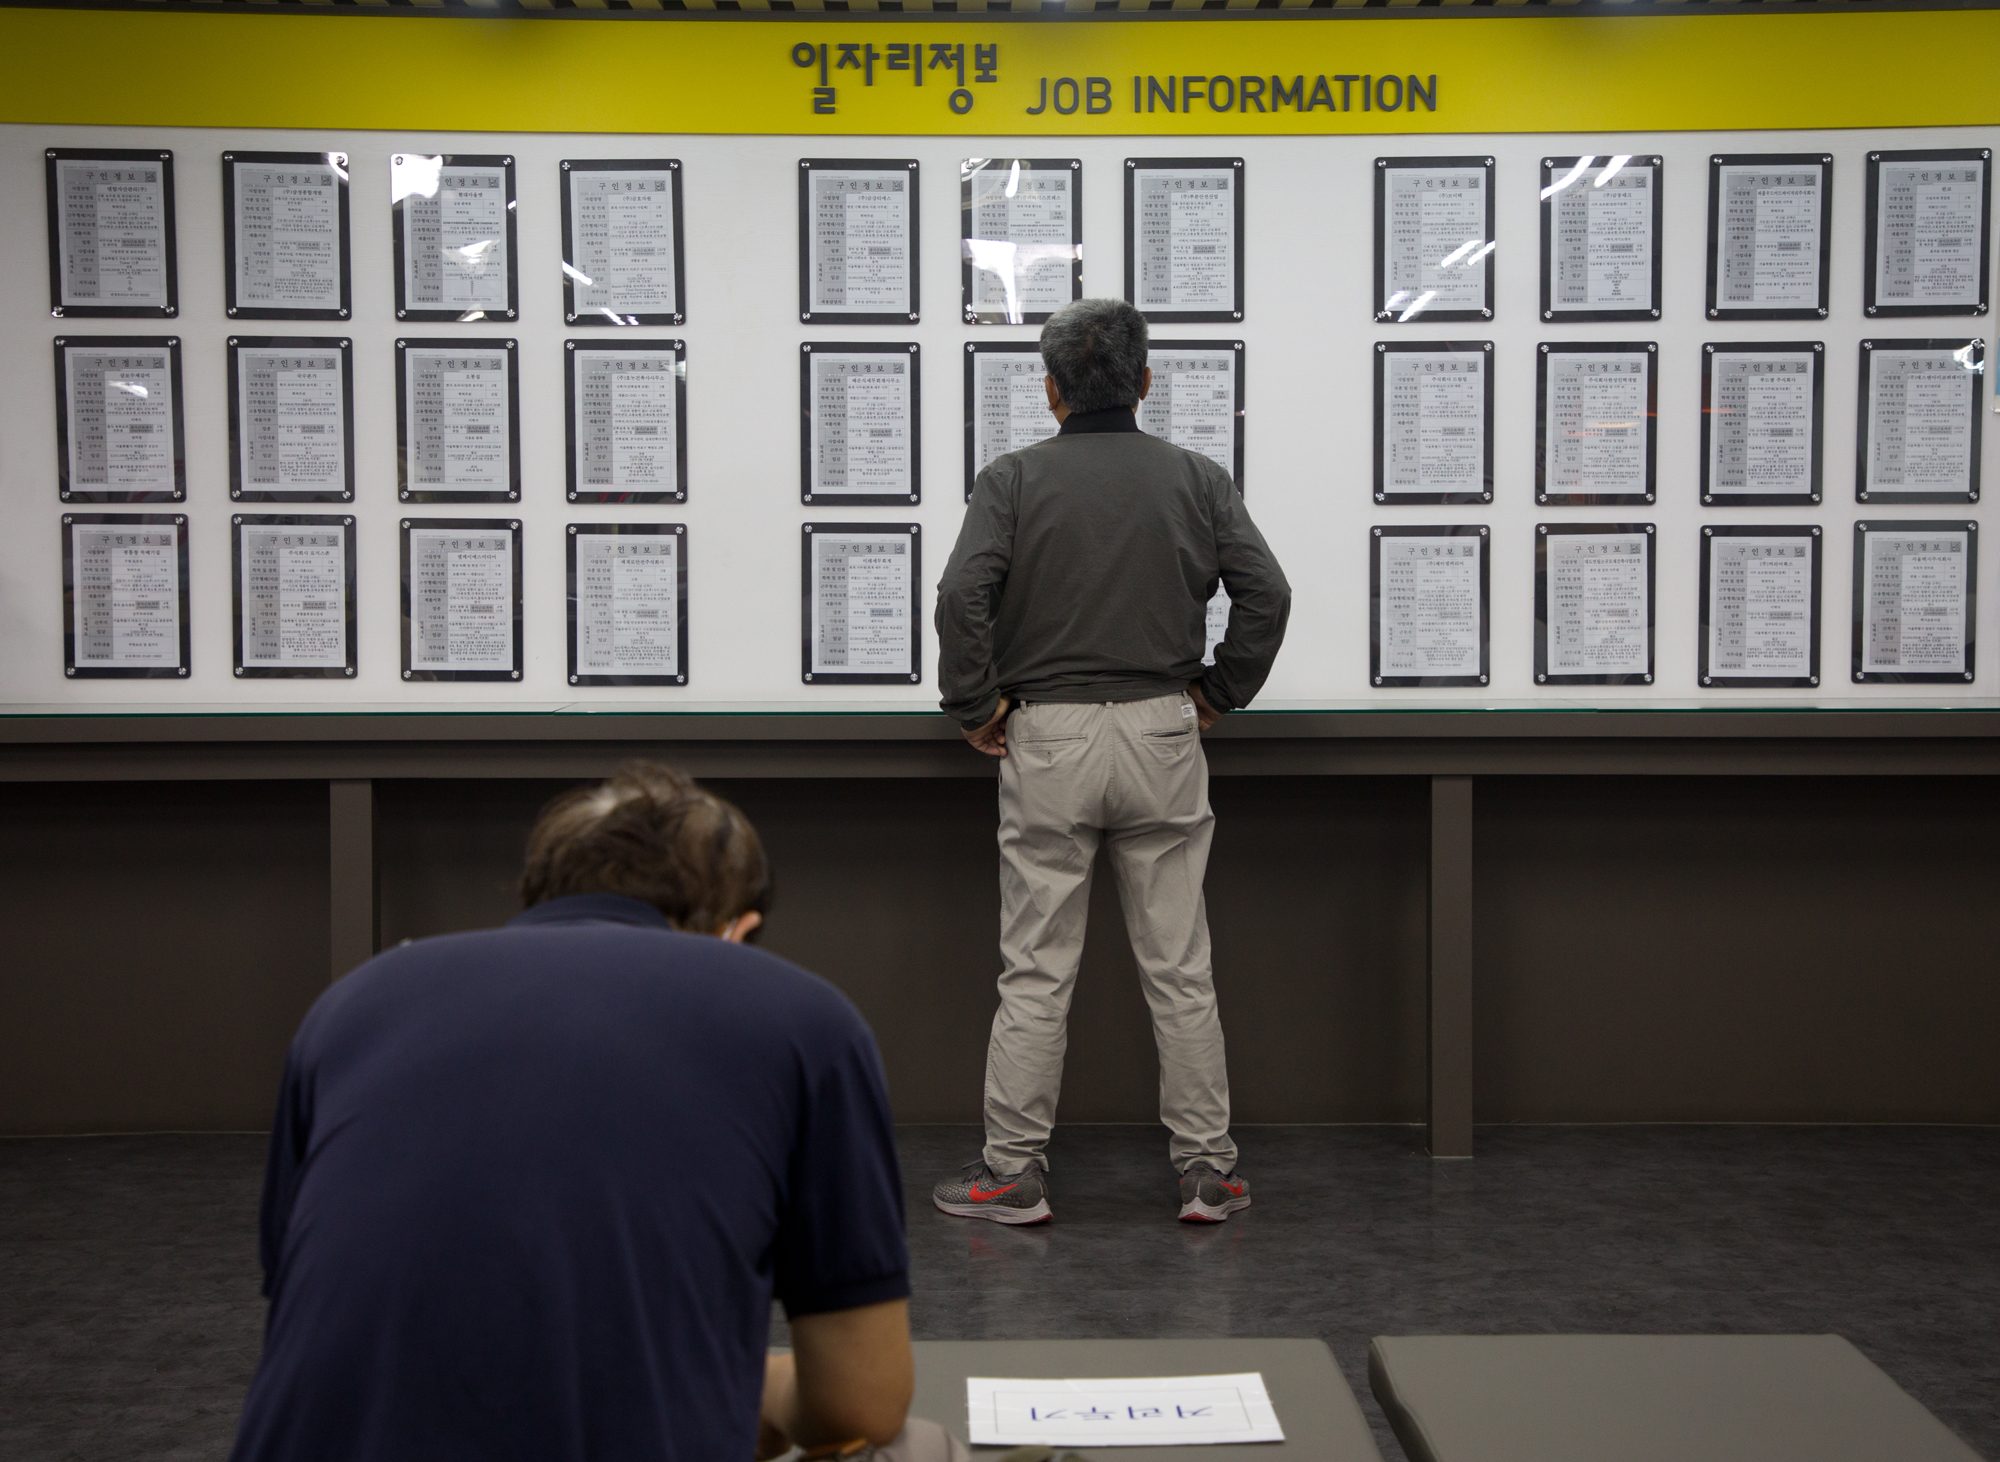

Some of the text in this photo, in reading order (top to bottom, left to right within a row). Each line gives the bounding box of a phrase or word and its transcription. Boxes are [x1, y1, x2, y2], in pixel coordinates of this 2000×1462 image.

[792, 42, 998, 115] 일자리정보
[1026, 73, 1438, 115] JOB INFORMATION
[86, 171, 135, 181] 구인정보
[263, 174, 312, 184] 구인정보
[1748, 176, 1795, 185] 구인정보
[1908, 172, 1956, 181] 구인정보
[445, 178, 479, 187] 인정보
[599, 182, 646, 191] 구인정보
[837, 181, 883, 190] 구인정보
[1000, 181, 1046, 189] 구정보
[1162, 180, 1208, 189] 구인정보
[1413, 179, 1459, 188] 구인정보
[1579, 179, 1626, 188] 구정보
[94, 358, 143, 368] 구인정보
[267, 359, 315, 368] 구인정보
[434, 360, 481, 369] 구인정보
[602, 361, 649, 370] 구인정보
[1163, 361, 1209, 370] 구인정보
[1412, 363, 1458, 372] 구인정보
[1575, 363, 1621, 372] 구인정보
[1740, 363, 1787, 372] 구인정보
[1898, 361, 1946, 370] 구인정보
[838, 364, 884, 373] 구인정보
[101, 535, 150, 545] 구인정보
[269, 536, 318, 545] 구인정보
[438, 540, 485, 549] 구인정보
[604, 545, 651, 554] 구인정보
[839, 544, 885, 553] 구인정보
[1408, 547, 1454, 556] 구인정보
[1575, 545, 1621, 554] 구인정보
[1738, 547, 1785, 556] 구인정보
[1893, 543, 1941, 552] 구인정보
